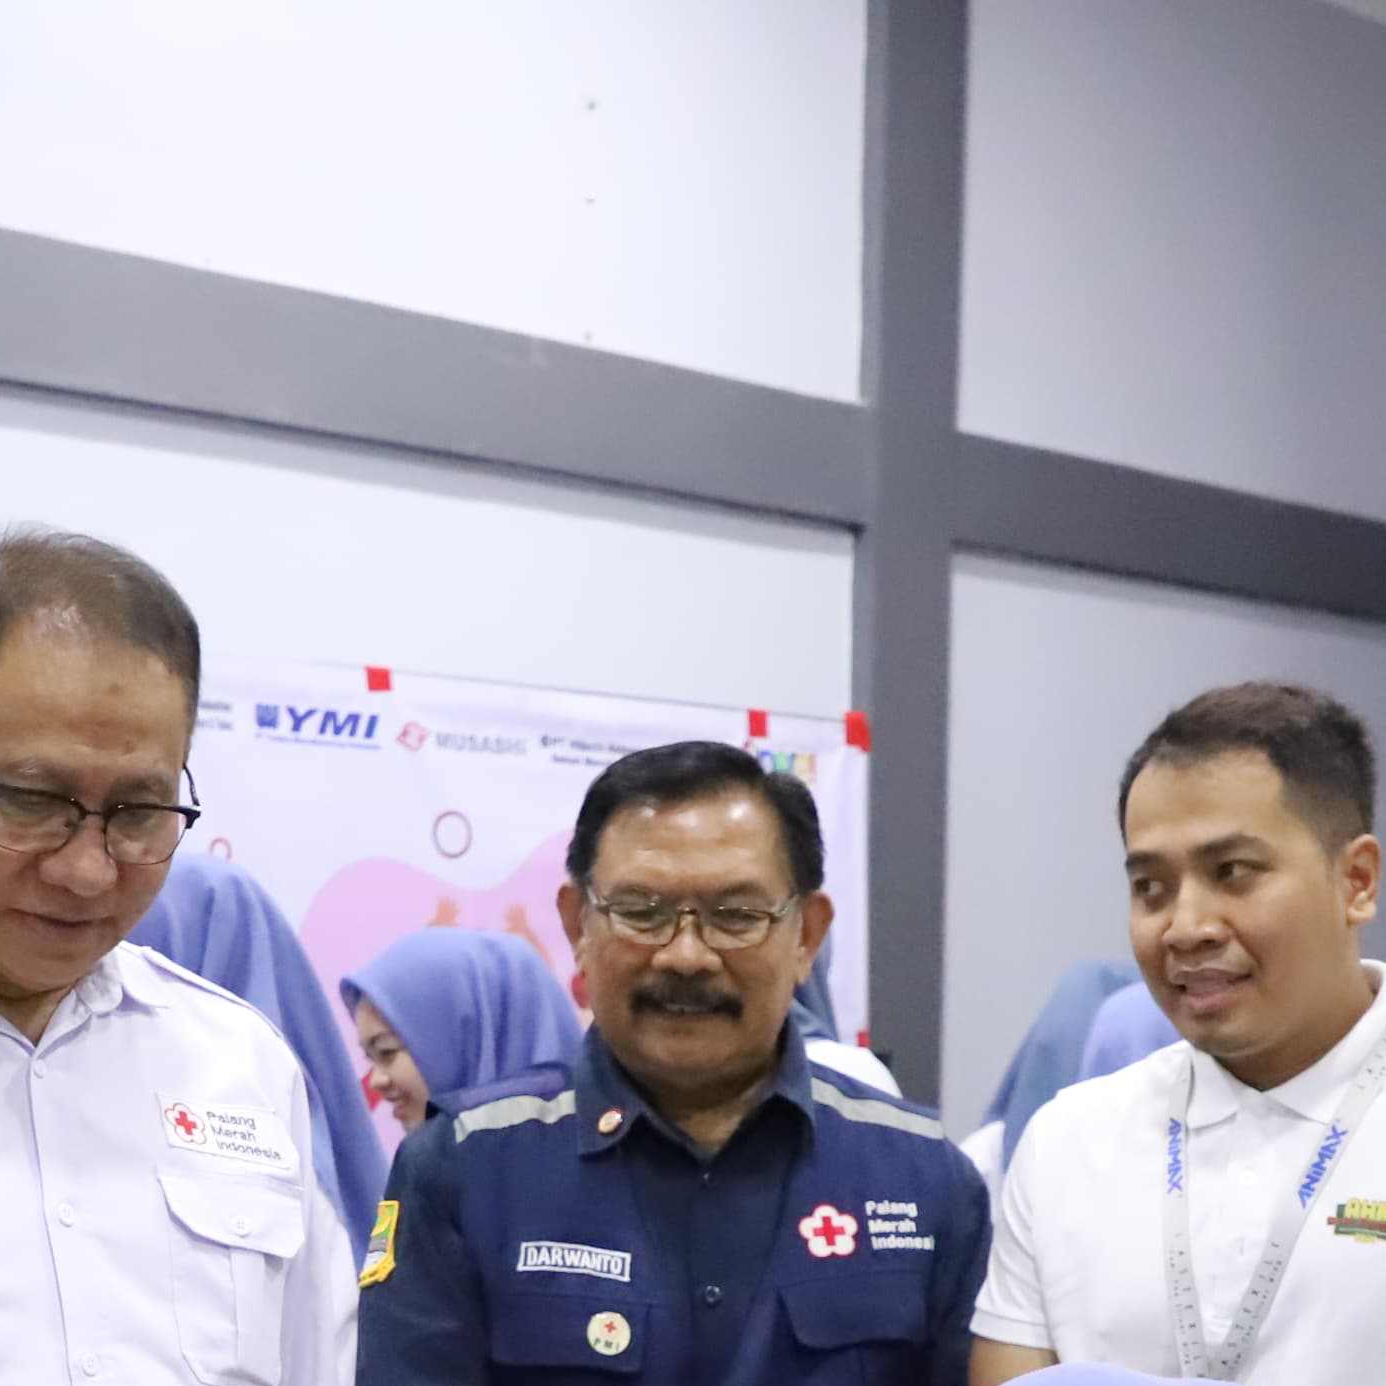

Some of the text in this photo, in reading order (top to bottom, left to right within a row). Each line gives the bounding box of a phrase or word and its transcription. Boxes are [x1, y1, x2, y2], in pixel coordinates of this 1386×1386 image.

[285, 706, 380, 740] YMI
[206, 1110, 257, 1130] Palang
[210, 1123, 257, 1142] Merah
[215, 1139, 282, 1161] Indonesia
[1167, 1116, 1184, 1195] ANIMAX
[1297, 1124, 1349, 1209] ANIMAX
[864, 1200, 919, 1218] Palang
[867, 1218, 917, 1234] Merah
[526, 1246, 624, 1275] DARWANTO
[593, 1337, 621, 1353] PMI
